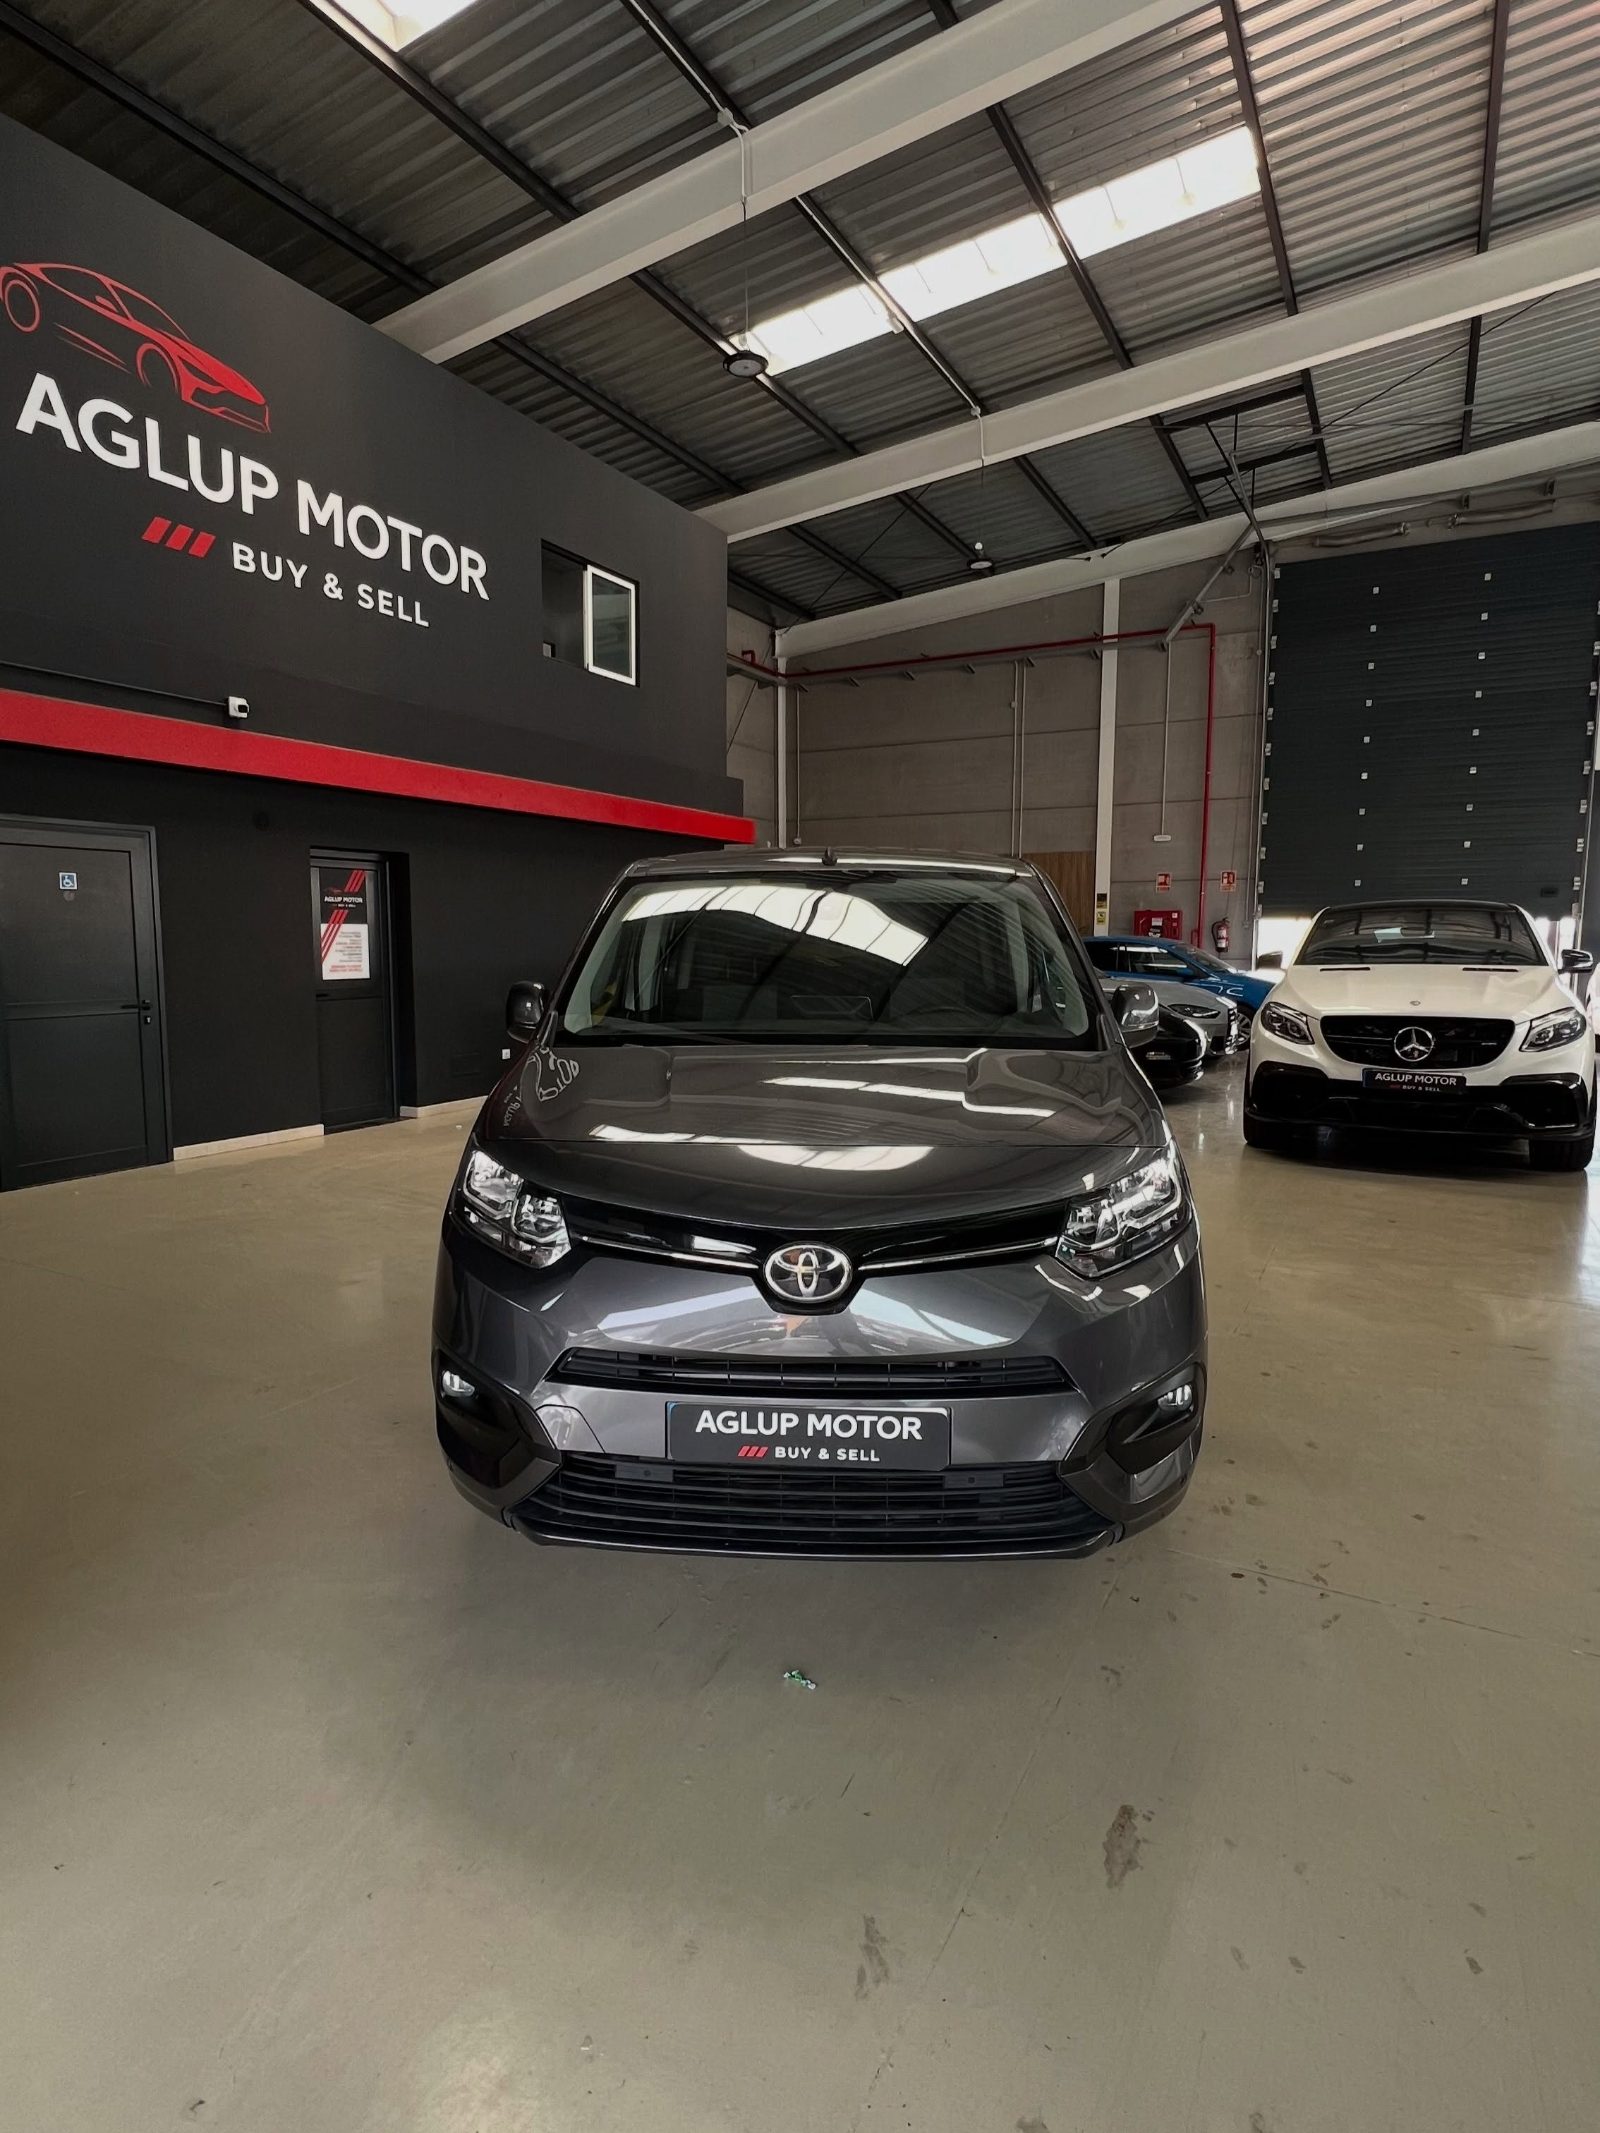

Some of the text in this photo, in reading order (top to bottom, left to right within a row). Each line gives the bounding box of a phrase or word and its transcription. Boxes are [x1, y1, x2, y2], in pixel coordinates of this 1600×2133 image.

[15, 372, 490, 601] AGLUP MOTOR
[232, 542, 429, 627] BUY & SELL
[1375, 1073, 1457, 1086] AGLUP MOTOR
[695, 1409, 923, 1440] AGLUP MOTOR
[774, 1446, 880, 1462] BUY & SELL
